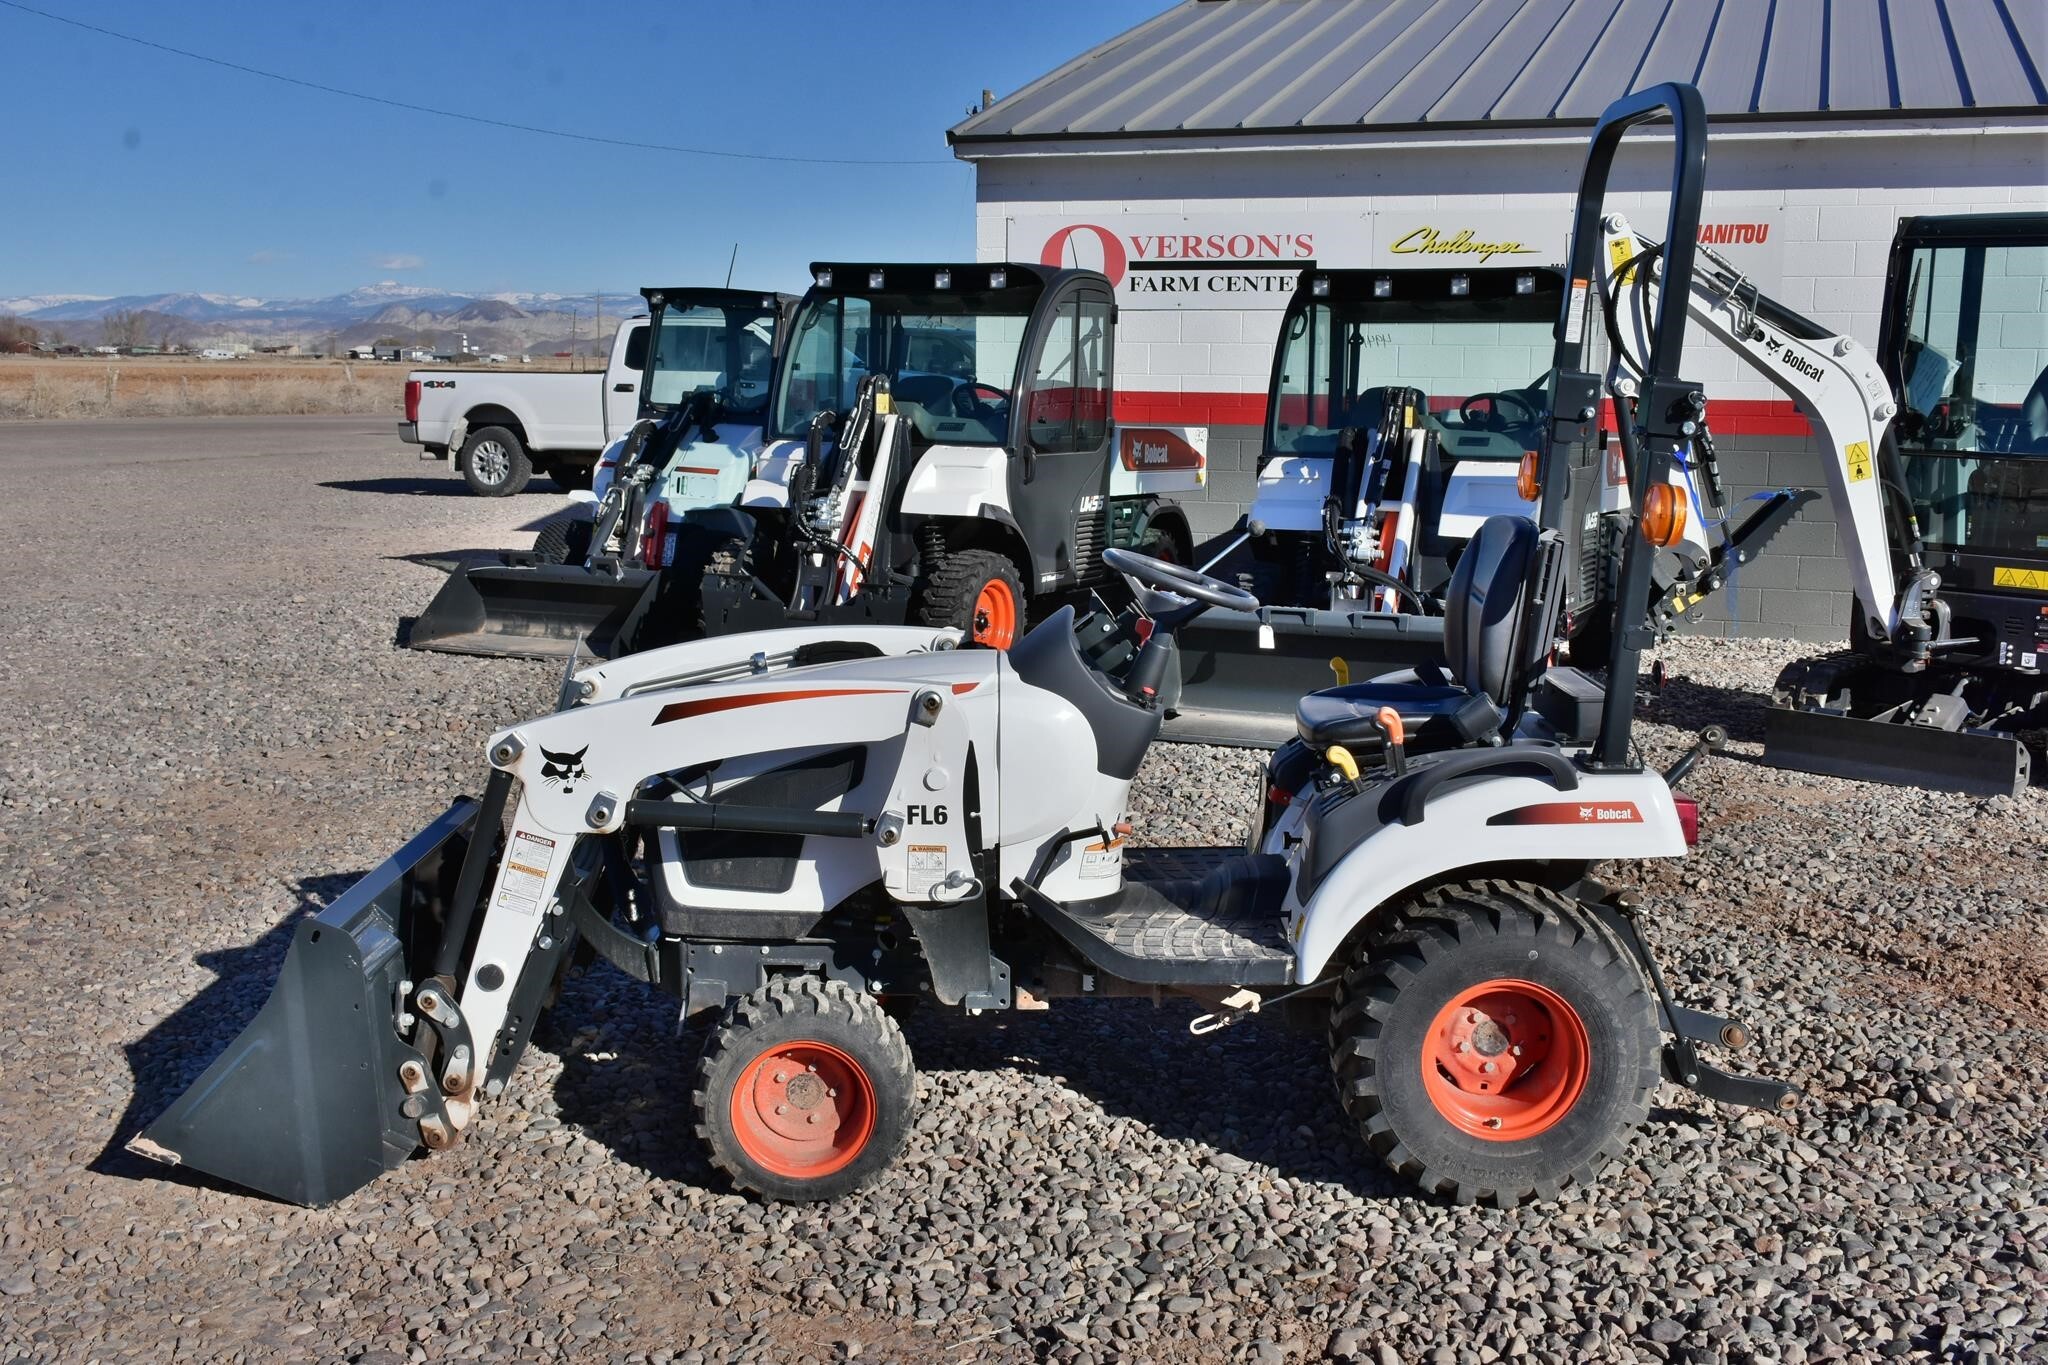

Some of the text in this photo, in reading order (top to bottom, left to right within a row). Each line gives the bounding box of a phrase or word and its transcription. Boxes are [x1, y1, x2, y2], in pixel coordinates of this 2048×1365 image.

[1391, 225, 1542, 263] Challenger
[1129, 275, 1300, 292] FARM CENTE
[1781, 348, 1825, 382] Bobcat
[1144, 443, 1168, 463] Bobcat
[906, 804, 948, 825] FL6
[1596, 808, 1632, 820] Bobcat
[525, 833, 552, 847] DANGER
[516, 864, 543, 878] WARNING
